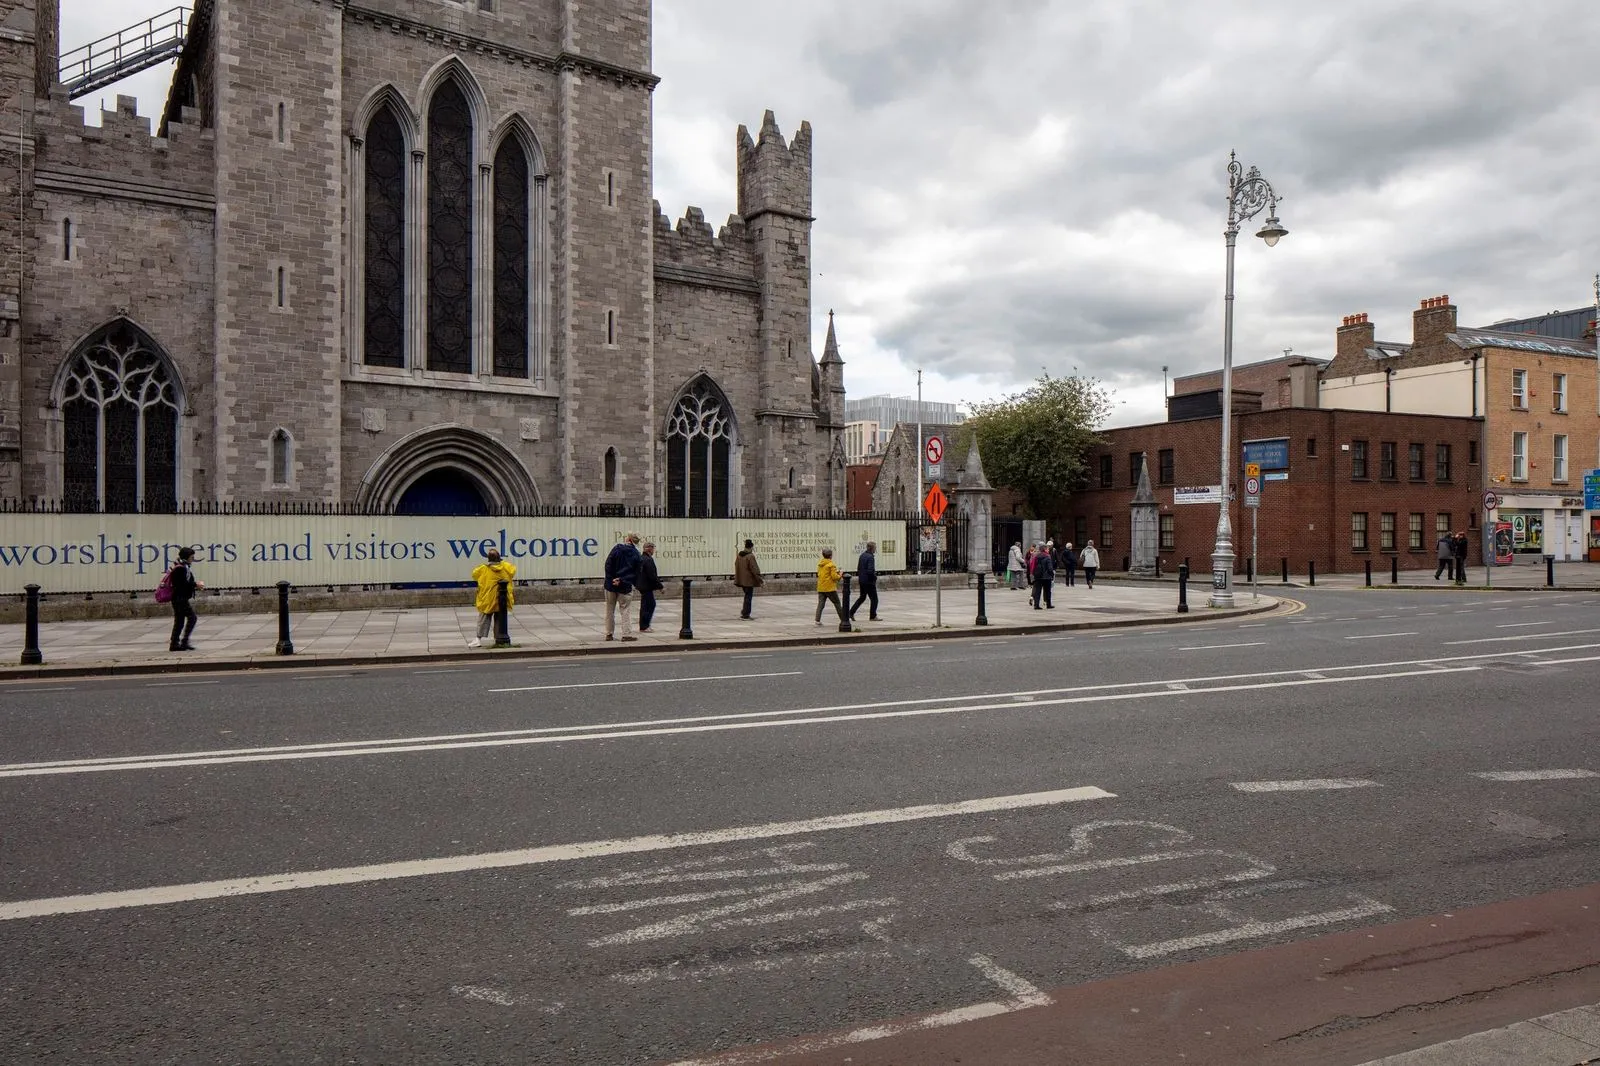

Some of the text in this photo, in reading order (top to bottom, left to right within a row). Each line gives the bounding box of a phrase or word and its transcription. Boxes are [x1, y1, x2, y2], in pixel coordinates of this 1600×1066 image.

[659, 535, 679, 543] our
[0, 528, 599, 575] worshippers and visitors welcome
[662, 550, 684, 559] our
